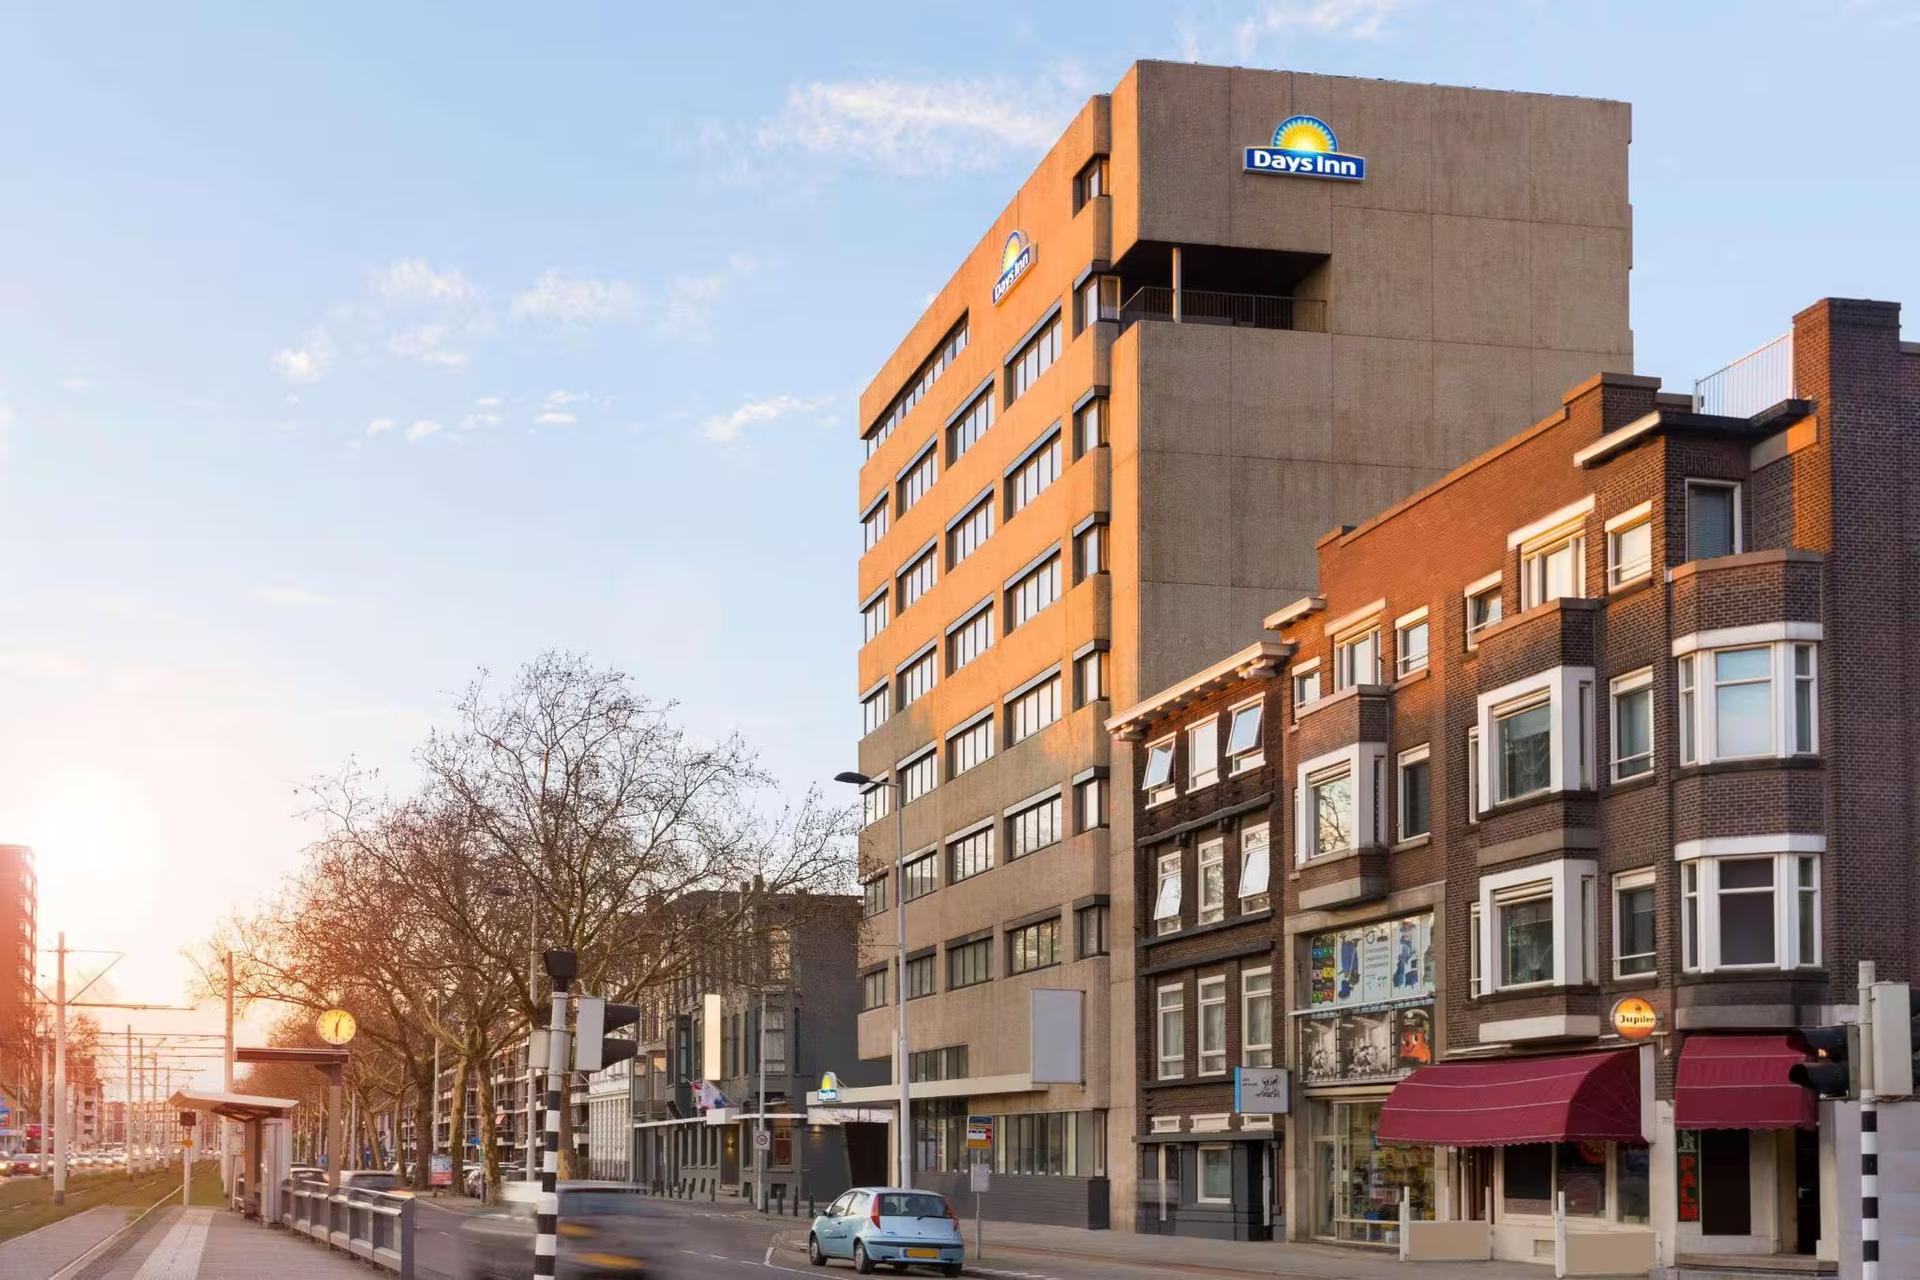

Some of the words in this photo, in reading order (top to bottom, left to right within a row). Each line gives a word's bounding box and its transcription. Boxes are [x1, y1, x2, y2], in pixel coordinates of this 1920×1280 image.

[1253, 149, 1314, 172] Days
[1316, 155, 1356, 175] Inn
[995, 269, 1014, 301] Days
[1014, 252, 1029, 278] Inn
[1620, 1014, 1655, 1025] Jupiler
